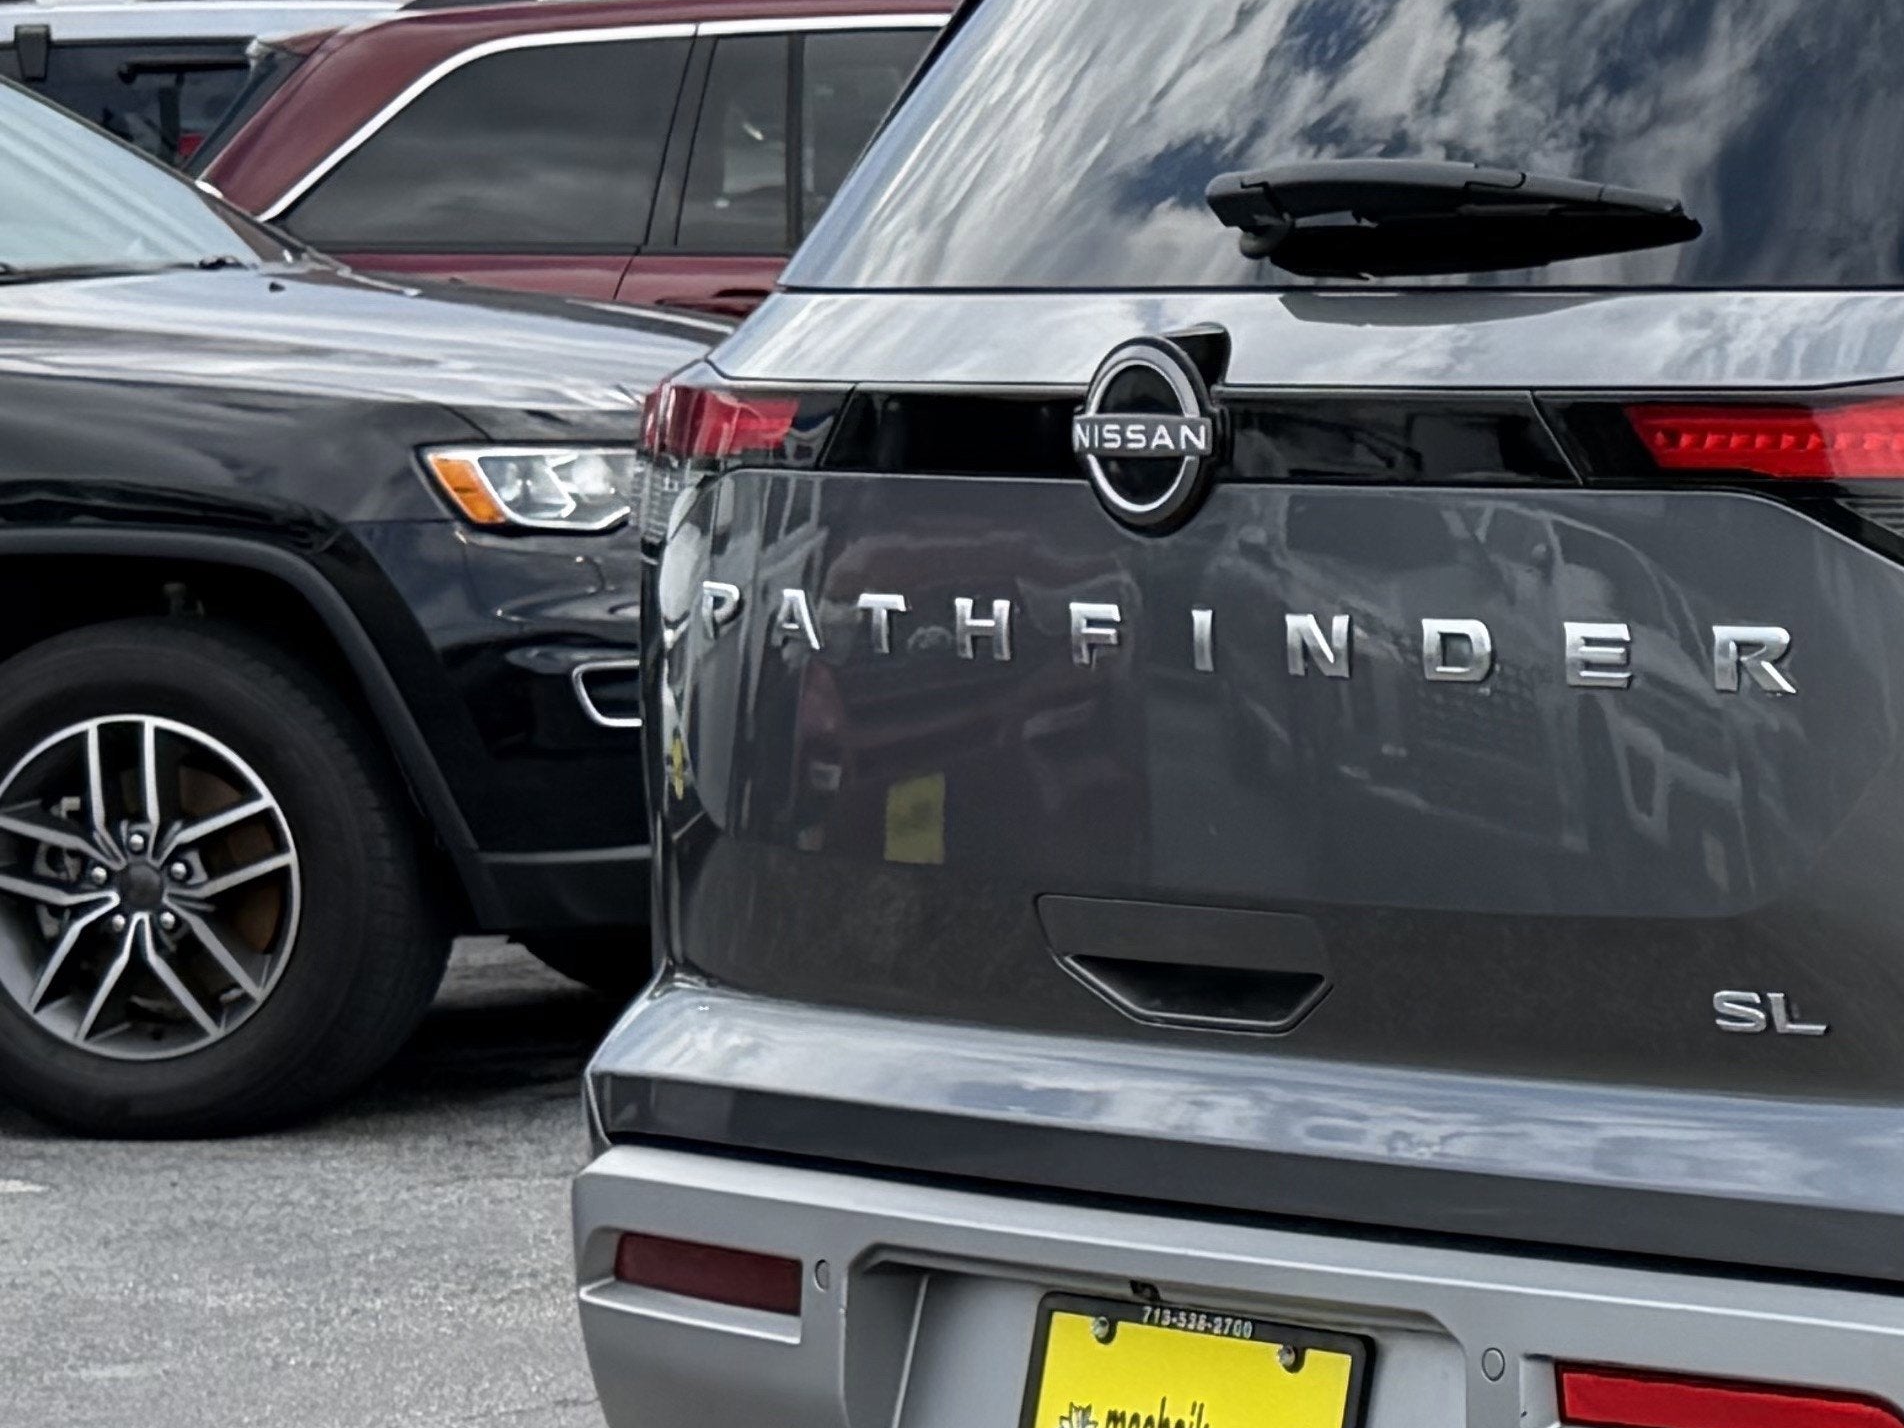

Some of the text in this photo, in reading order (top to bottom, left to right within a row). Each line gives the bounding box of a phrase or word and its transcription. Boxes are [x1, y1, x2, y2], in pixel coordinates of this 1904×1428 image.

[1073, 424, 1206, 452] NISSAN
[700, 580, 1797, 695] PATHFINDER
[1711, 989, 1829, 1037] SL
